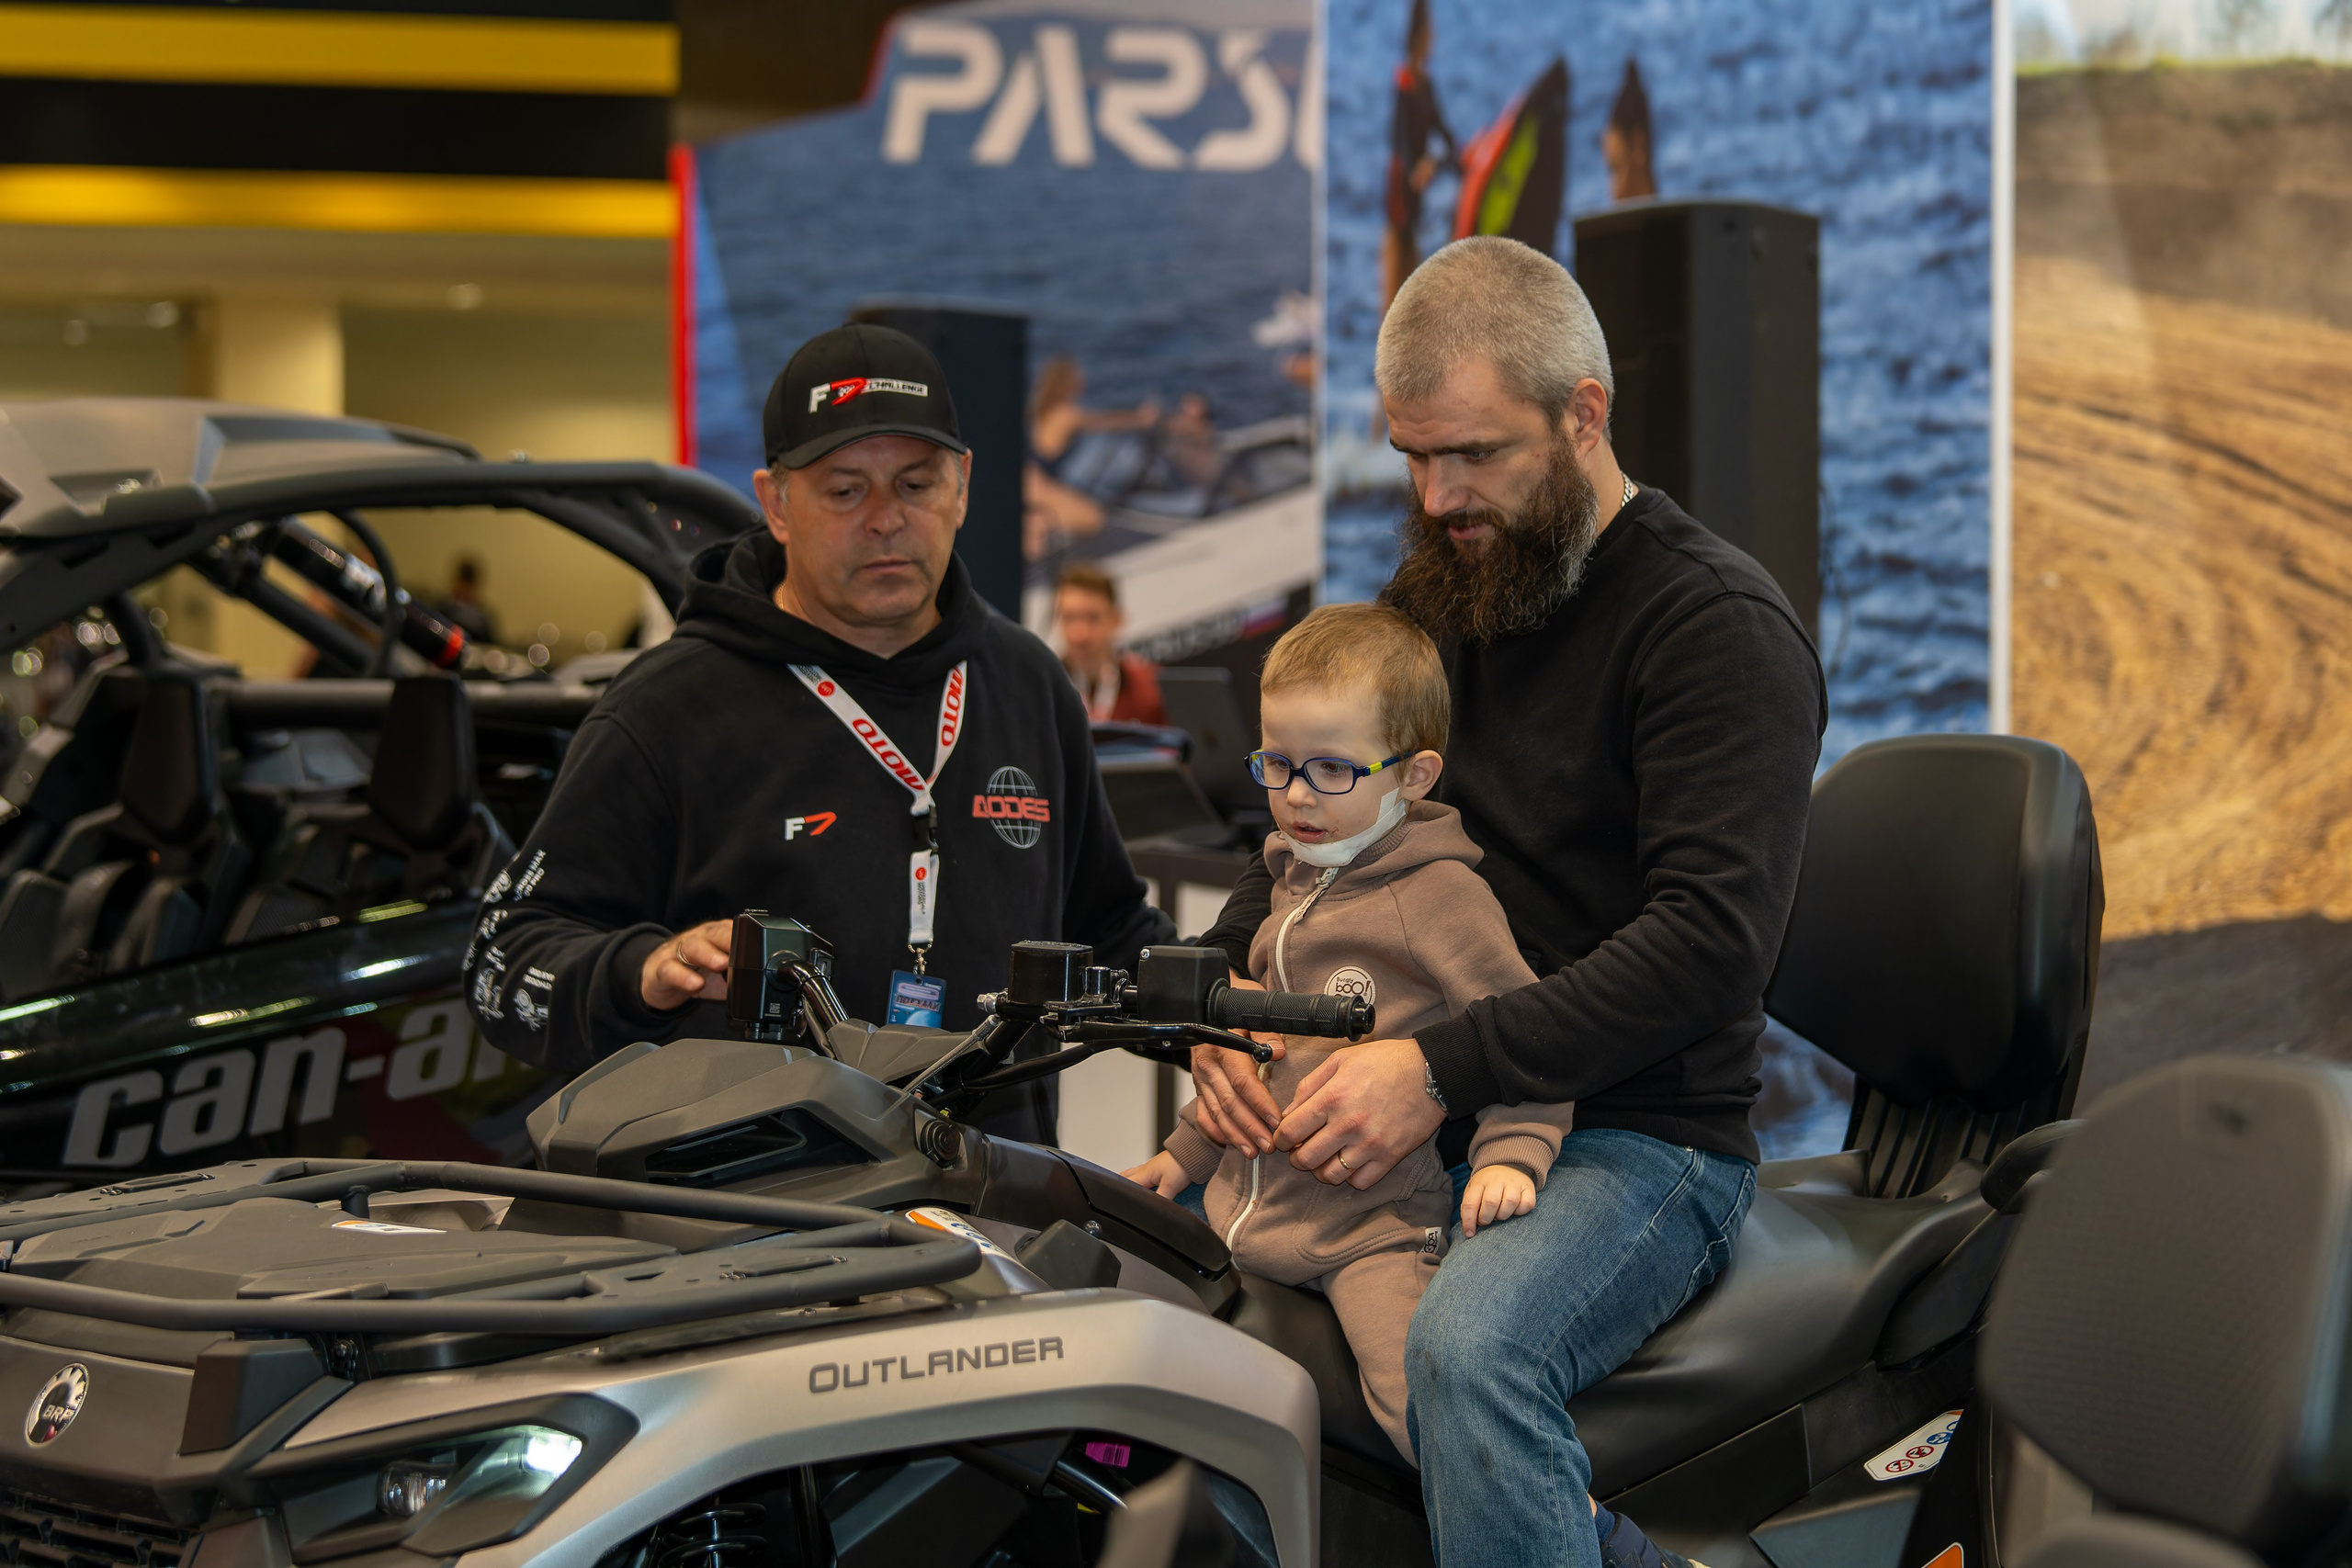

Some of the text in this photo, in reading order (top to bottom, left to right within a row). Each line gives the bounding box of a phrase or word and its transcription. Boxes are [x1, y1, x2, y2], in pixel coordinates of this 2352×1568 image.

[882, 20, 1320, 172] PARS
[942, 667, 963, 746] MOTO
[853, 719, 924, 790] MOTO
[972, 794, 1050, 822] AODES
[808, 1336, 1064, 1393] OUTLANDER
[42, 1404, 75, 1423] BRP
